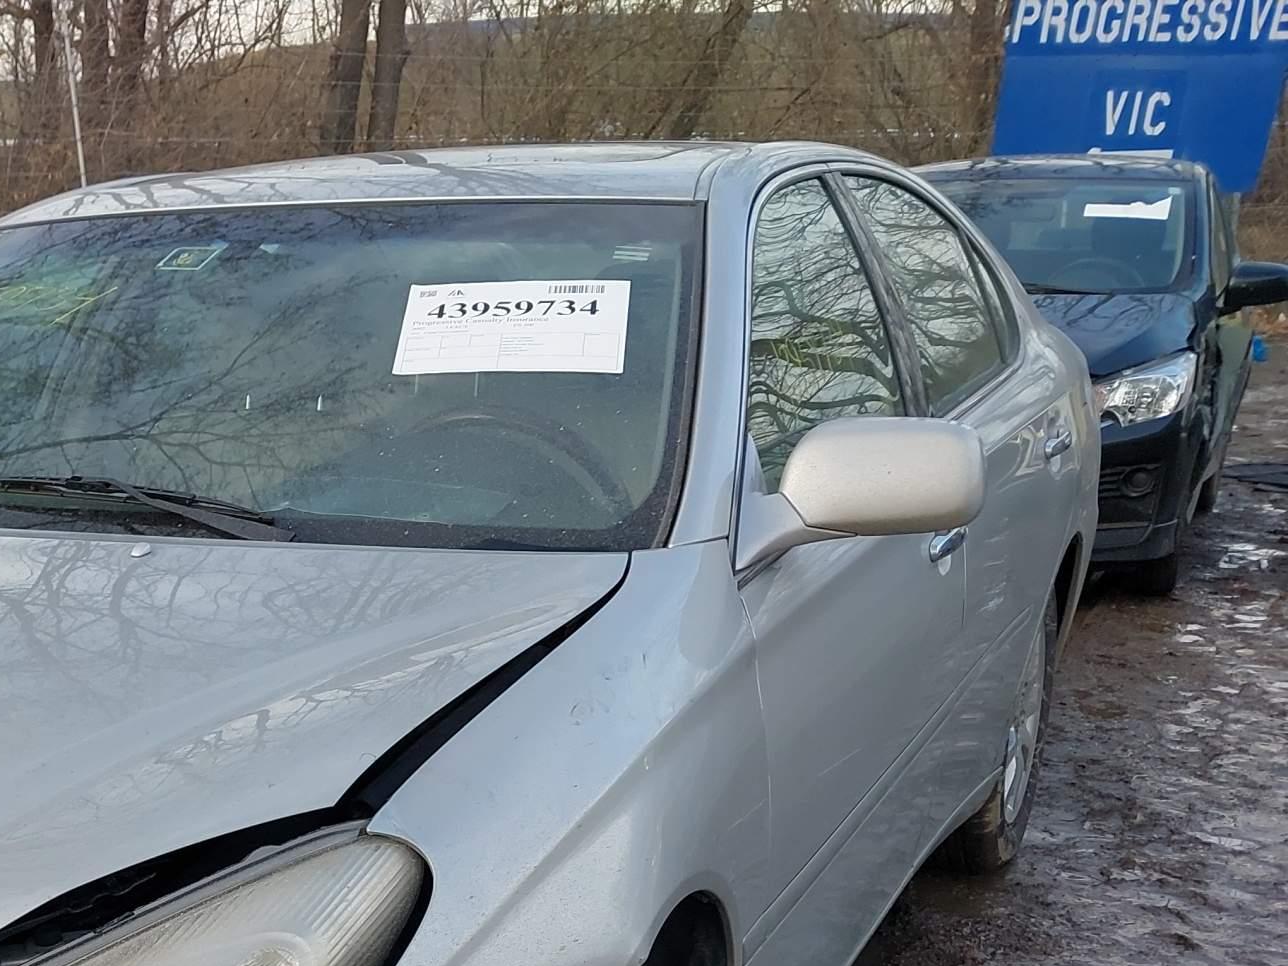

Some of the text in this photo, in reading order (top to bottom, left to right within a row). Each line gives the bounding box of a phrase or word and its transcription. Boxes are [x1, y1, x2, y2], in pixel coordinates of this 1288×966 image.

[1012, 0, 1288, 43] PROGRESSIVE
[1105, 90, 1171, 136] VIC
[427, 300, 600, 319] 43959734
